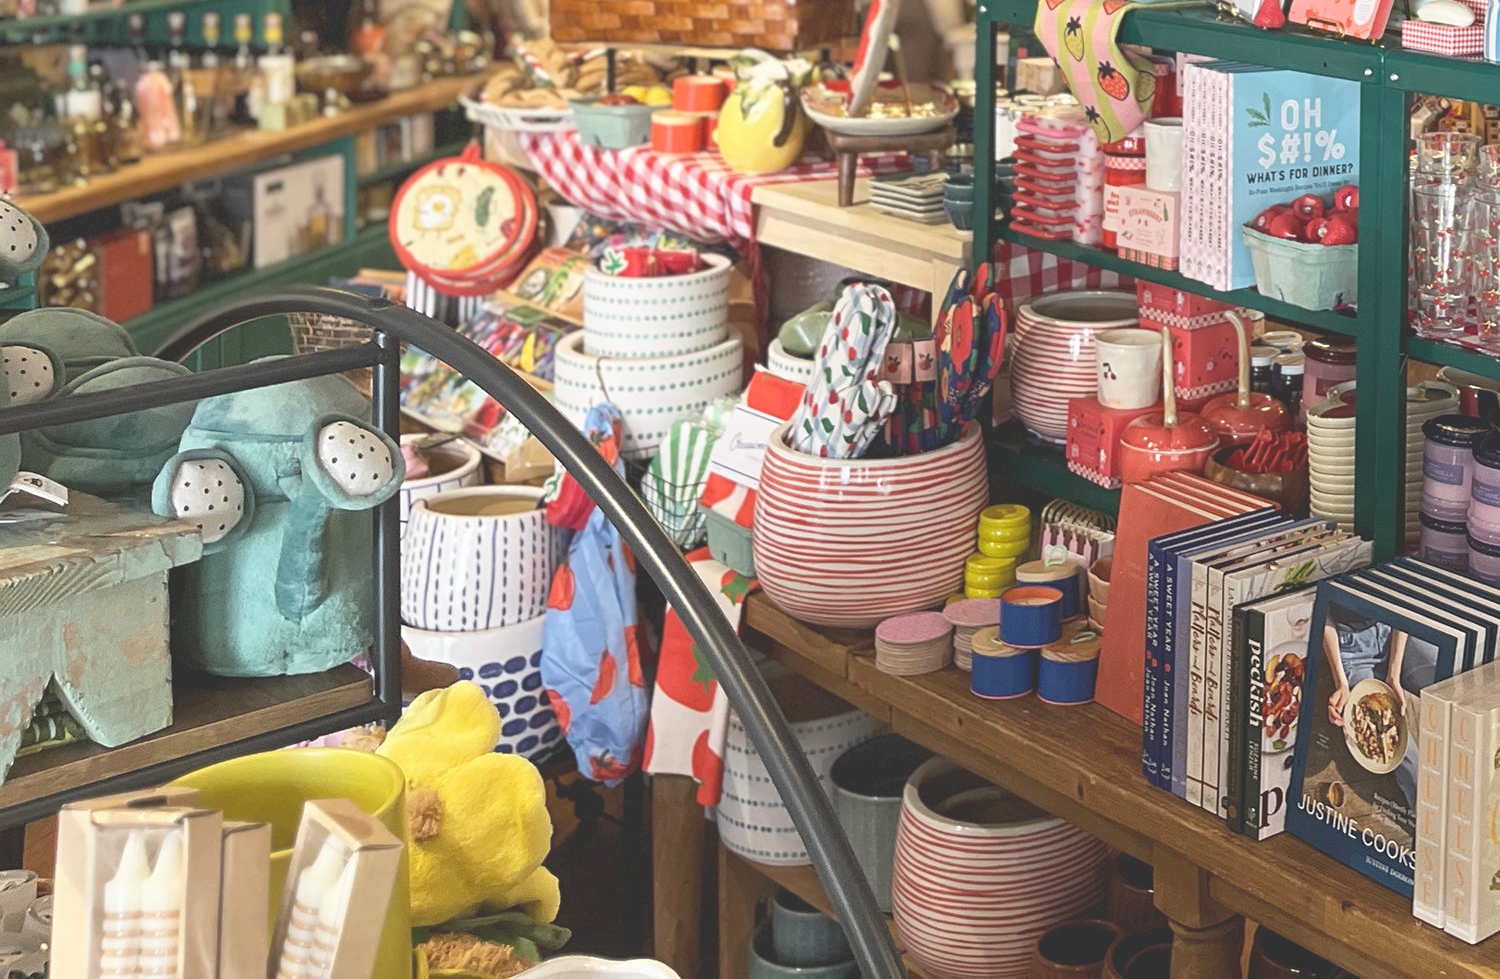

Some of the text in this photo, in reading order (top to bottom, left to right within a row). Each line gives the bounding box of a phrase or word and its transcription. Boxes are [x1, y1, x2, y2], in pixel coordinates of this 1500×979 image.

[1281, 98, 1321, 131] OH
[1258, 129, 1345, 169] $#!%
[1247, 163, 1353, 184] WHAT'S FOR DINNER?
[1164, 621, 1172, 653] YEAR
[1207, 605, 1222, 658] Platters
[1204, 675, 1218, 722] Boards
[1248, 638, 1265, 727] peckish
[1297, 794, 1358, 840] JUSTINE
[1362, 827, 1416, 870] COOKS
